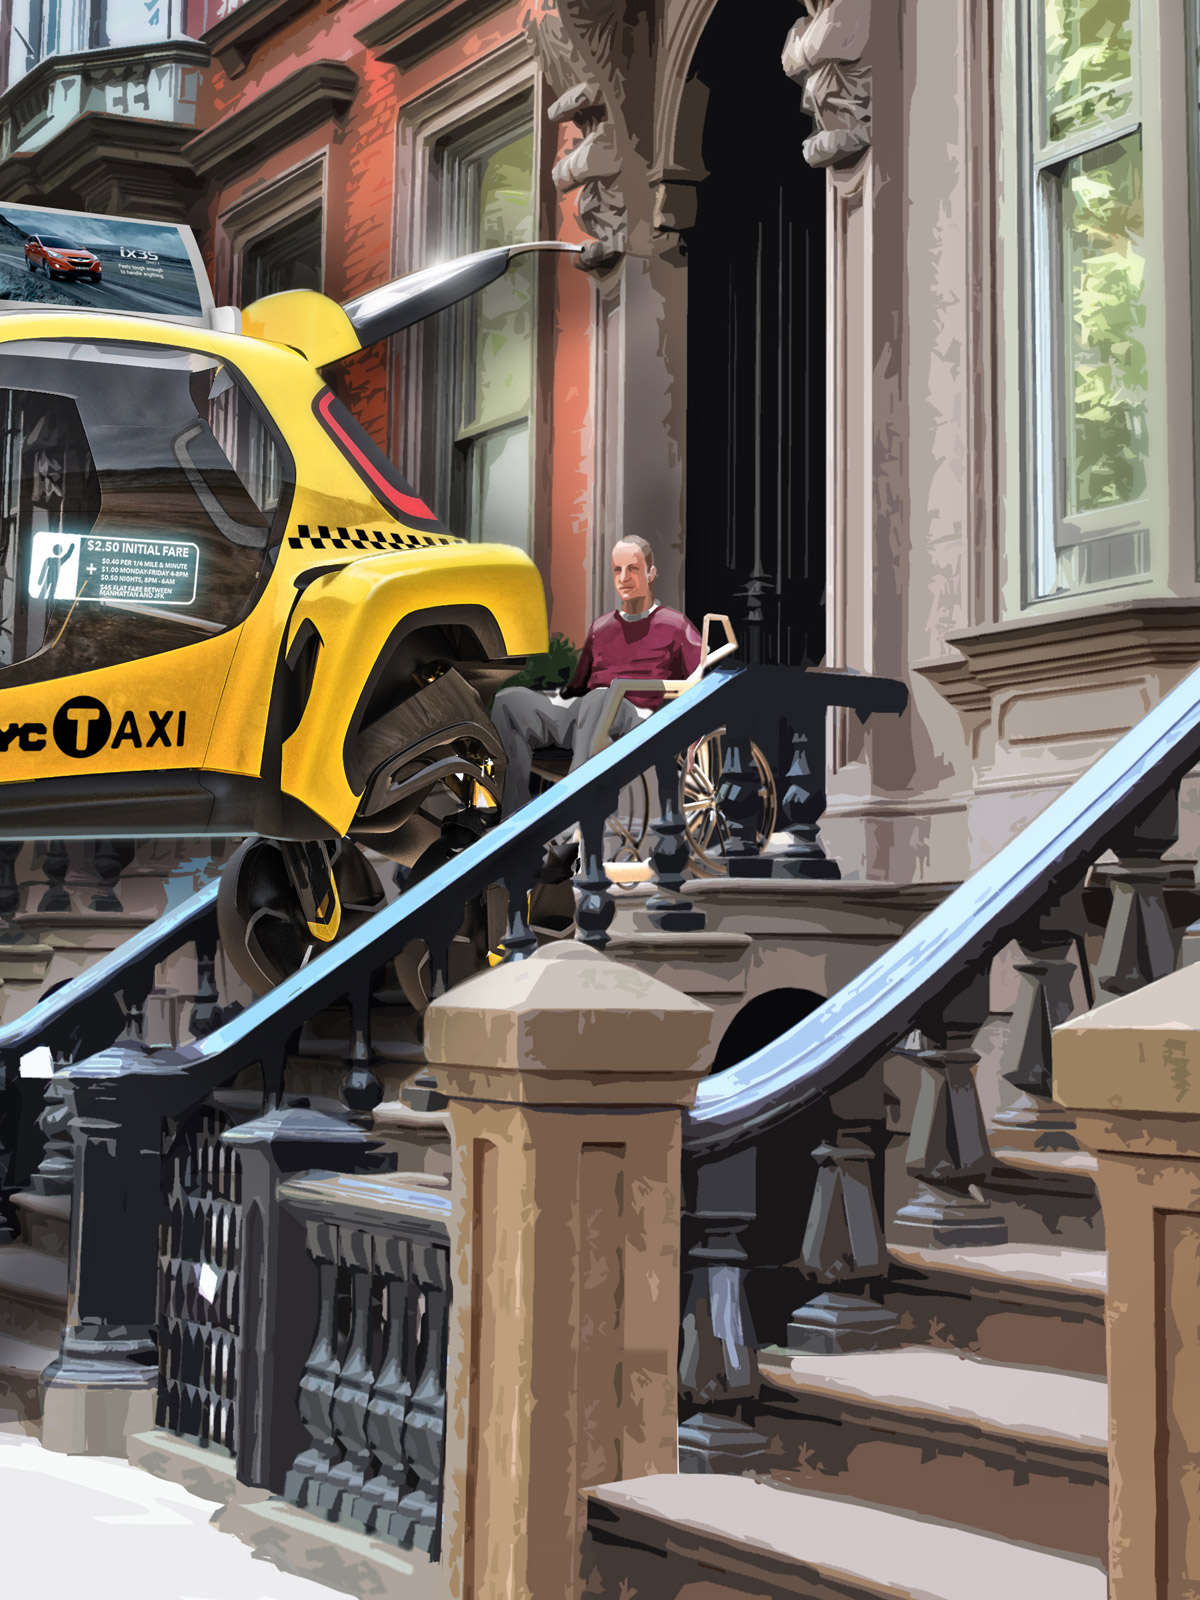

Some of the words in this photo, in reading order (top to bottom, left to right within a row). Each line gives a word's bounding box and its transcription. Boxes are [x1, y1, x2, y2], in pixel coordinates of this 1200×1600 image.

[120, 246, 159, 261] ix35
[87, 540, 119, 552] $2.50
[122, 542, 160, 556] INITIAL
[162, 546, 189, 557] FARE
[165, 562, 187, 570] MINUTE
[120, 567, 169, 576] MONDAY-FRIDAY
[99, 589, 139, 598] MANHATTAN
[144, 586, 173, 594] BETWEEN
